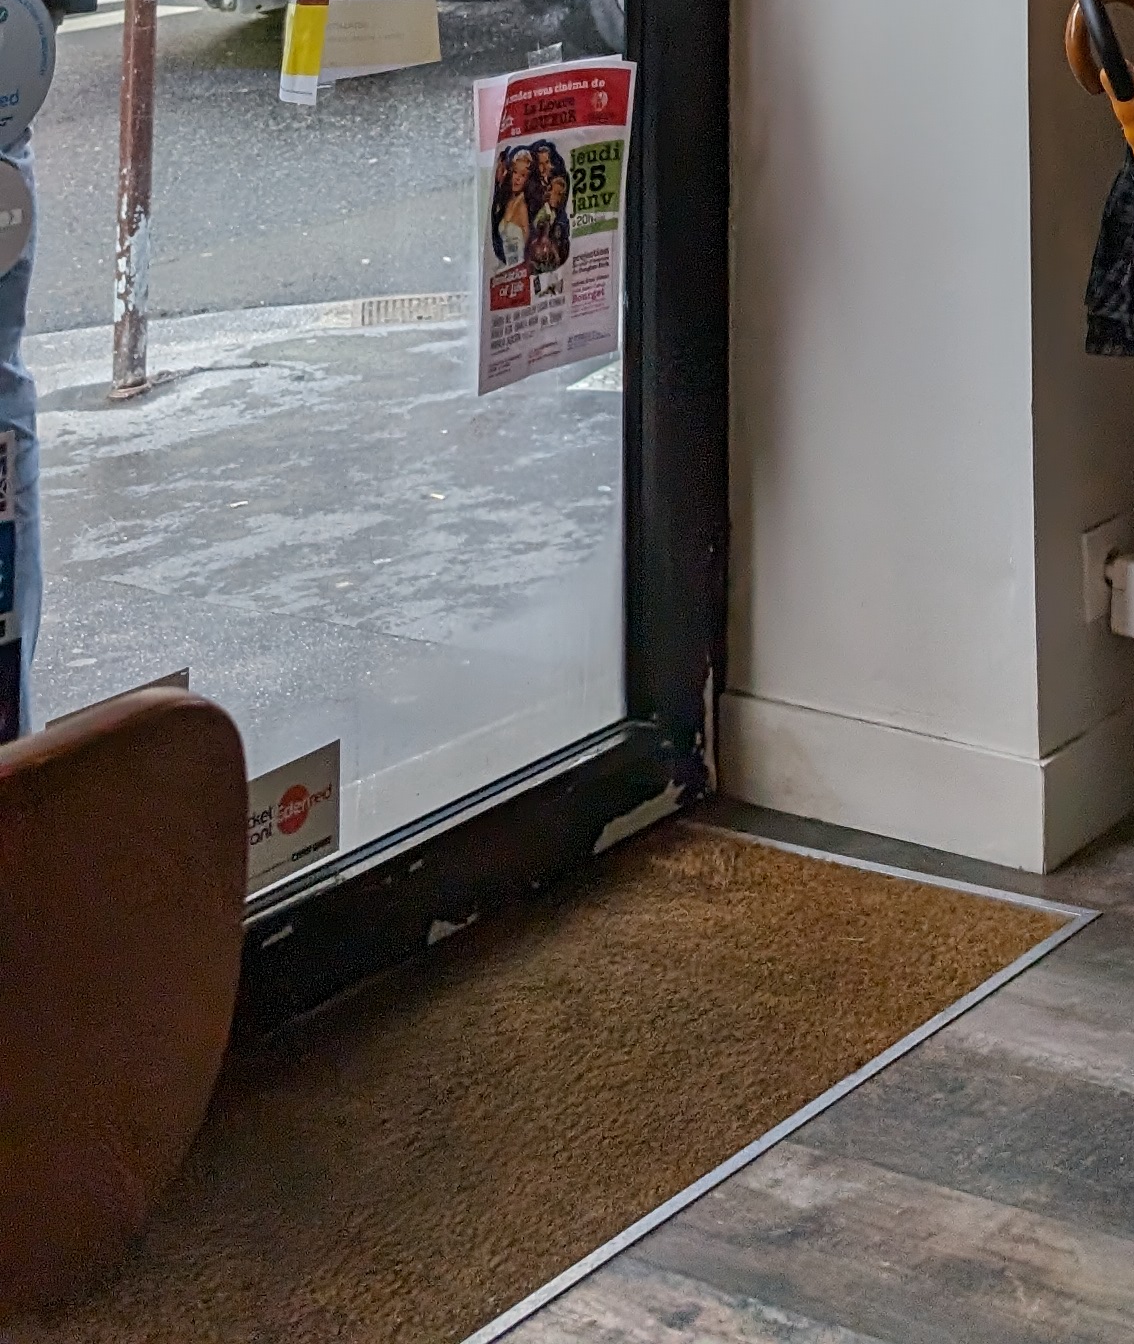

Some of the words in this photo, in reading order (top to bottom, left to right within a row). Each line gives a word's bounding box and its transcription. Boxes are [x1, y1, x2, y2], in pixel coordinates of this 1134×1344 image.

[570, 143, 622, 173] jeudi
[572, 164, 607, 195] 25
[570, 191, 616, 218] janv
